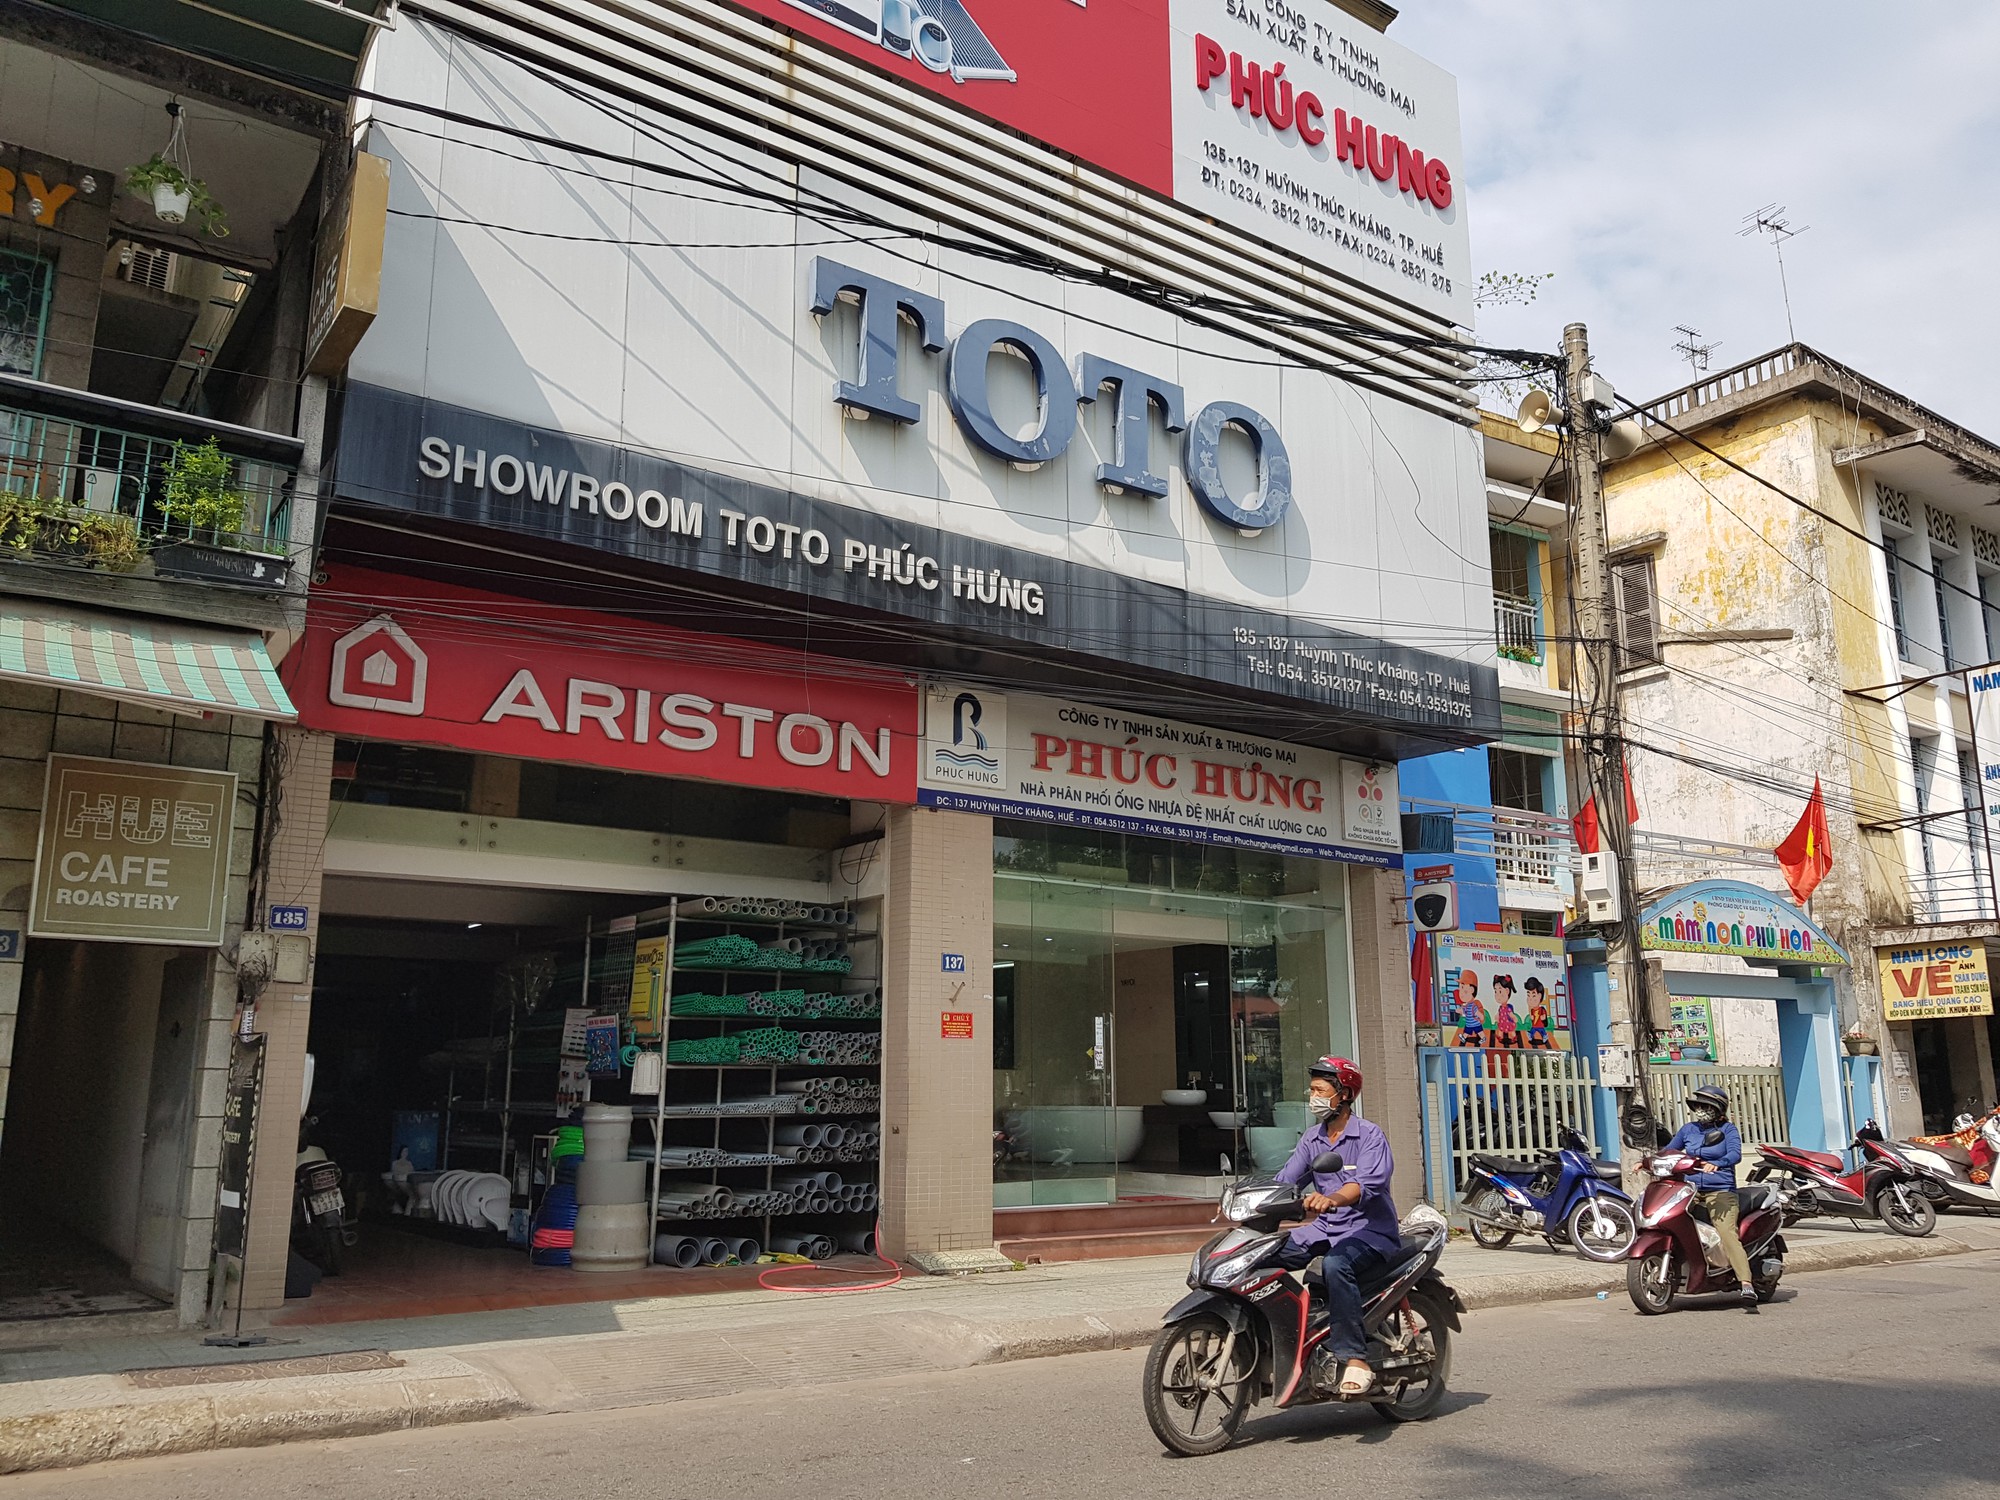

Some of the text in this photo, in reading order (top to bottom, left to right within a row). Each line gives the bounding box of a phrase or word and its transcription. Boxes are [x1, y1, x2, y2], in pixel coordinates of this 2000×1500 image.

[1226, 0, 1260, 29] SẢN
[1313, 46, 1323, 64] &
[1328, 53, 1385, 97] THƯƠNG
[1391, 88, 1415, 115] MẠI
[1265, 0, 1379, 72] CÔNG TY TNHH
[1195, 32, 1452, 208] PHÚC HƯNG
[1312, 189, 1345, 219] THÚC
[1271, 199, 1299, 225] 3512
[1367, 243, 1395, 268] 0234
[1401, 259, 1426, 282] 3531
[1431, 273, 1452, 293] 375
[312, 253, 338, 324] CAFE
[808, 254, 1291, 531] TOTO
[418, 436, 1044, 615] SHOWROOM TOTO PHÚC HƯNG
[1233, 626, 1256, 645] 135
[1267, 636, 1288, 653] 137
[1294, 640, 1338, 665] Huỳnh
[1341, 652, 1374, 672] Thúc
[1247, 656, 1273, 675] Tel:
[1311, 671, 1361, 694] 3512137
[482, 668, 891, 776] ARISTON
[1059, 708, 1296, 764] CÔNG TY TNHH SẢN XUẤT & THƯƠNG MẠI
[935, 766, 999, 784] PHUC HUNG
[1030, 732, 1324, 813] PHÚC HƯNG
[64, 790, 214, 849] HUE
[936, 796, 952, 806] ĐC:
[955, 799, 968, 808] 137
[970, 800, 1000, 812] HUỲNH
[1002, 804, 1023, 815] THÚC
[1025, 807, 1056, 820] KHÁNG,
[1058, 811, 1074, 822] HUẾ
[1082, 815, 1093, 824] ĐT:
[1094, 818, 1125, 829] 054.3512
[1128, 823, 1139, 831] 137
[1146, 823, 1161, 834] FAX:
[1178, 829, 1193, 837] 3531
[1195, 831, 1207, 839] 375
[1213, 833, 1233, 843] Email:
[1319, 848, 1334, 857] Web:
[1335, 850, 1388, 864] Phuchunghue.com
[1020, 780, 1327, 838] NHÀ PHÂN PHỐI ỐNG NHỰA ĐỆ NHẤT CHẤT LƯỢNG CAO
[60, 851, 170, 887] CAFE
[56, 888, 180, 911] ROASTERY
[273, 912, 304, 925] 135
[1472, 952, 1483, 963] MỘT
[1706, 921, 1742, 946] NON
[1746, 922, 1777, 949] PHÚ
[1781, 925, 1812, 952] HÒA
[1891, 945, 1972, 964] NAM LONG
[945, 956, 963, 969] 137
[1891, 960, 1957, 998] VẼ
[1241, 1277, 1260, 1292] 110
